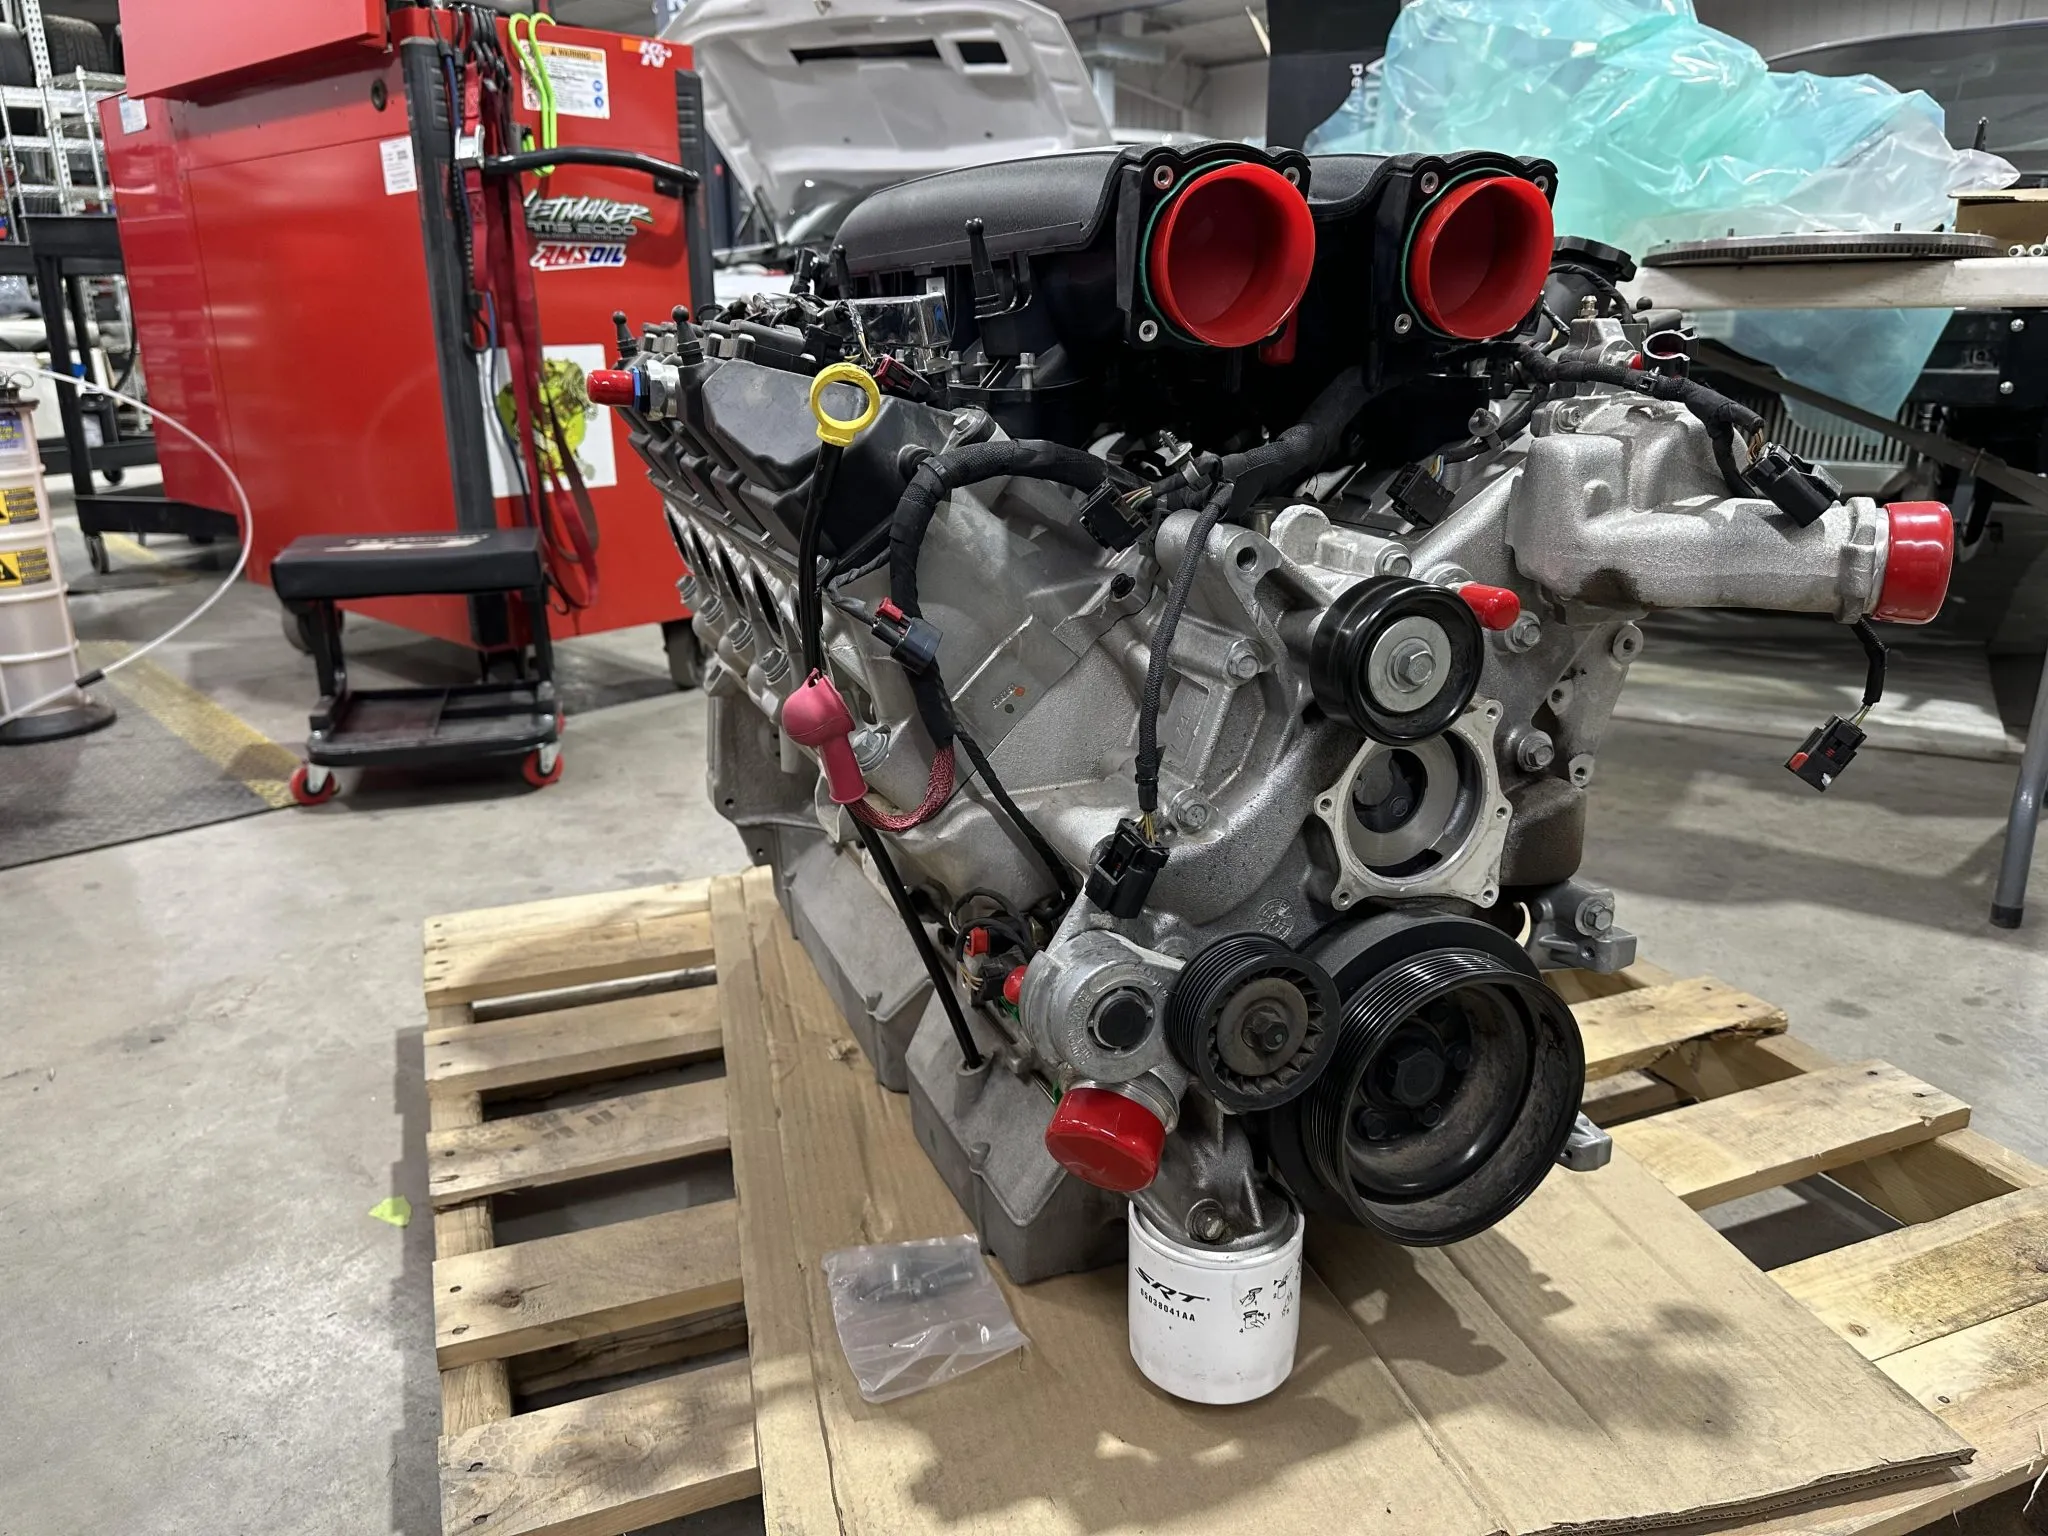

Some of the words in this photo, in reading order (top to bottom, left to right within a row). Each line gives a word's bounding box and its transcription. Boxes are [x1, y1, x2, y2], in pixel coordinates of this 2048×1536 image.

[577, 223, 637, 236] 2000
[533, 244, 626, 269] AMSOIL
[1135, 1267, 1206, 1303] SRT
